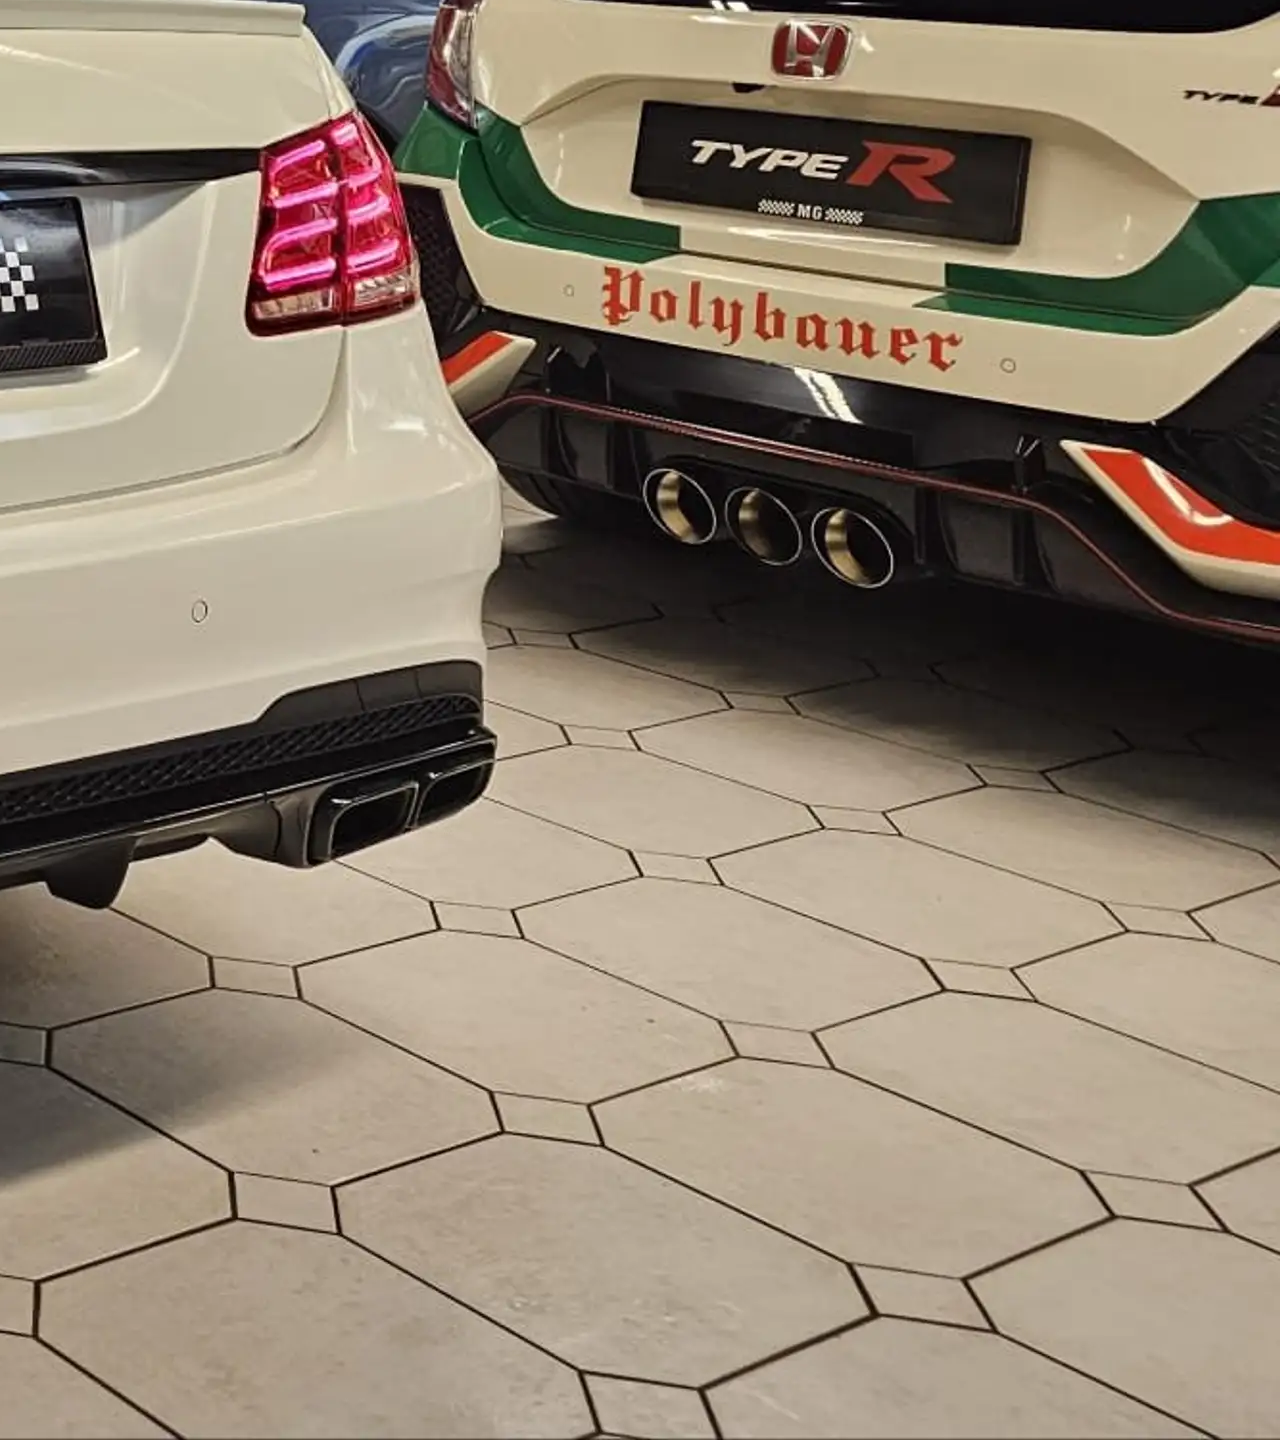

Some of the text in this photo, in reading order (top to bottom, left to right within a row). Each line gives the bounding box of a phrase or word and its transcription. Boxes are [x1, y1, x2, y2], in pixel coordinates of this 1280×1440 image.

[690, 140, 957, 204] TYPE R
[796, 204, 823, 222] MG
[602, 265, 964, 373] Polybauer
